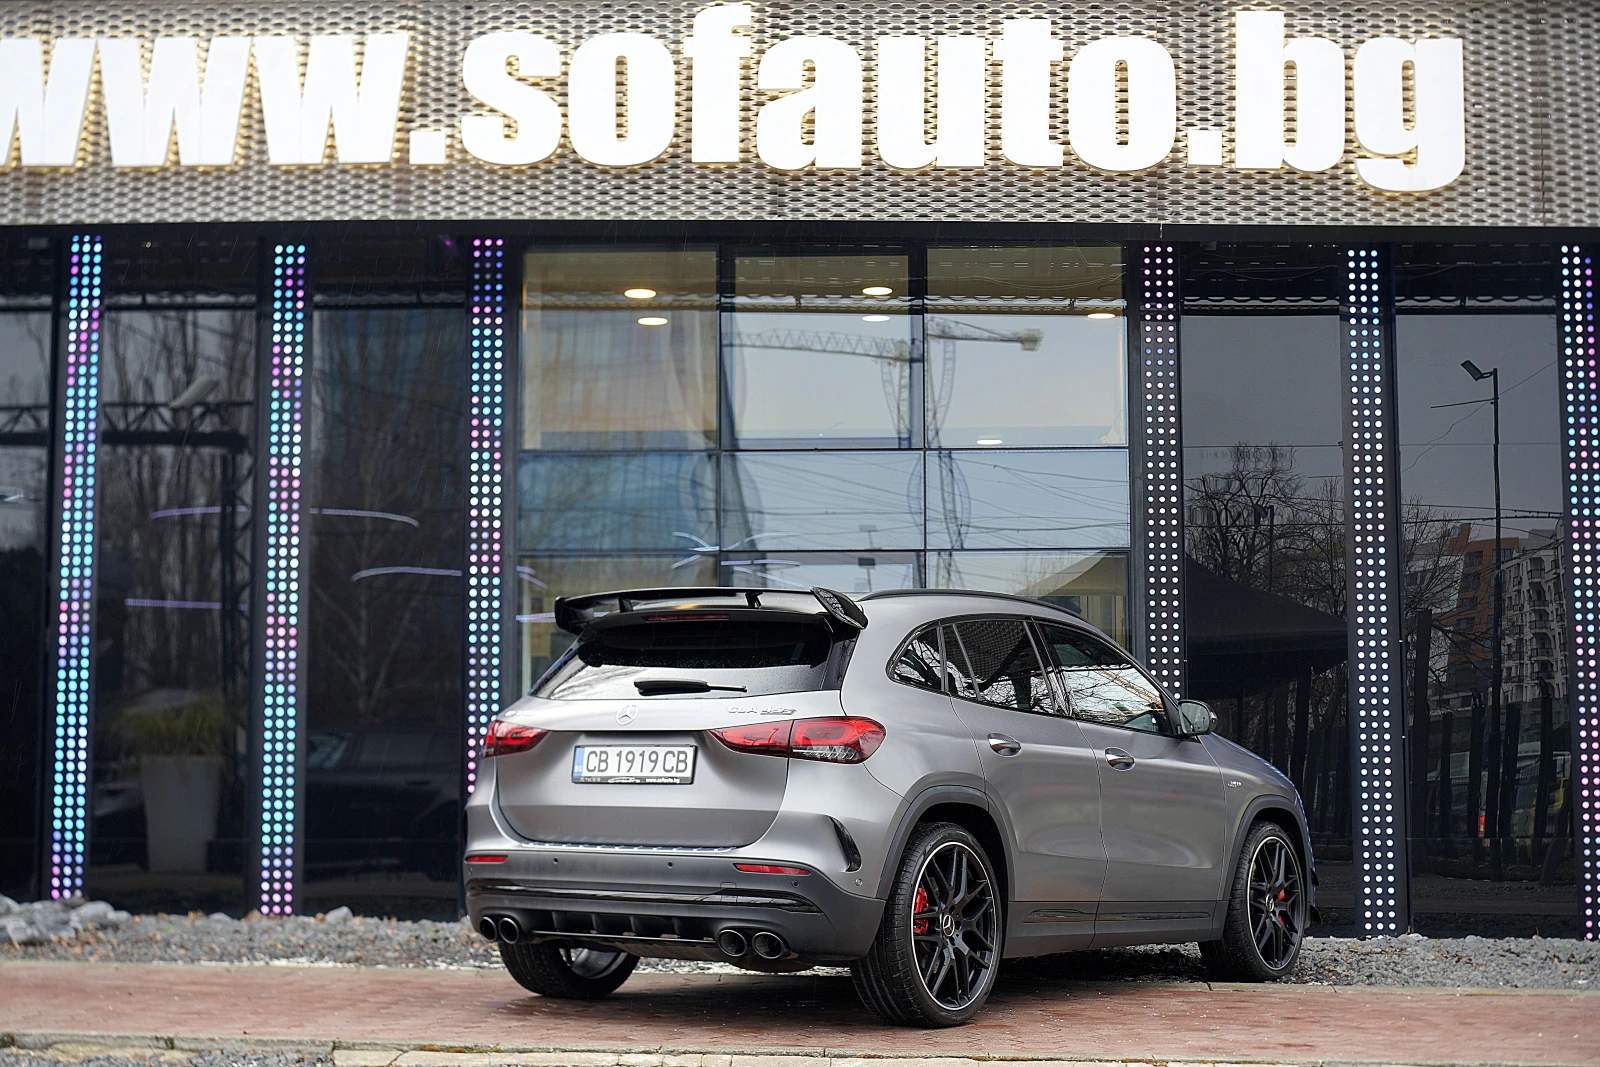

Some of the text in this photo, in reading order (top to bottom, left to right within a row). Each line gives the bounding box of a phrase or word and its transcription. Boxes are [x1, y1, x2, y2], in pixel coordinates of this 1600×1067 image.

[0, 3, 1465, 192] www.sofauto.bg
[586, 750, 688, 773] CB 1919 CB
